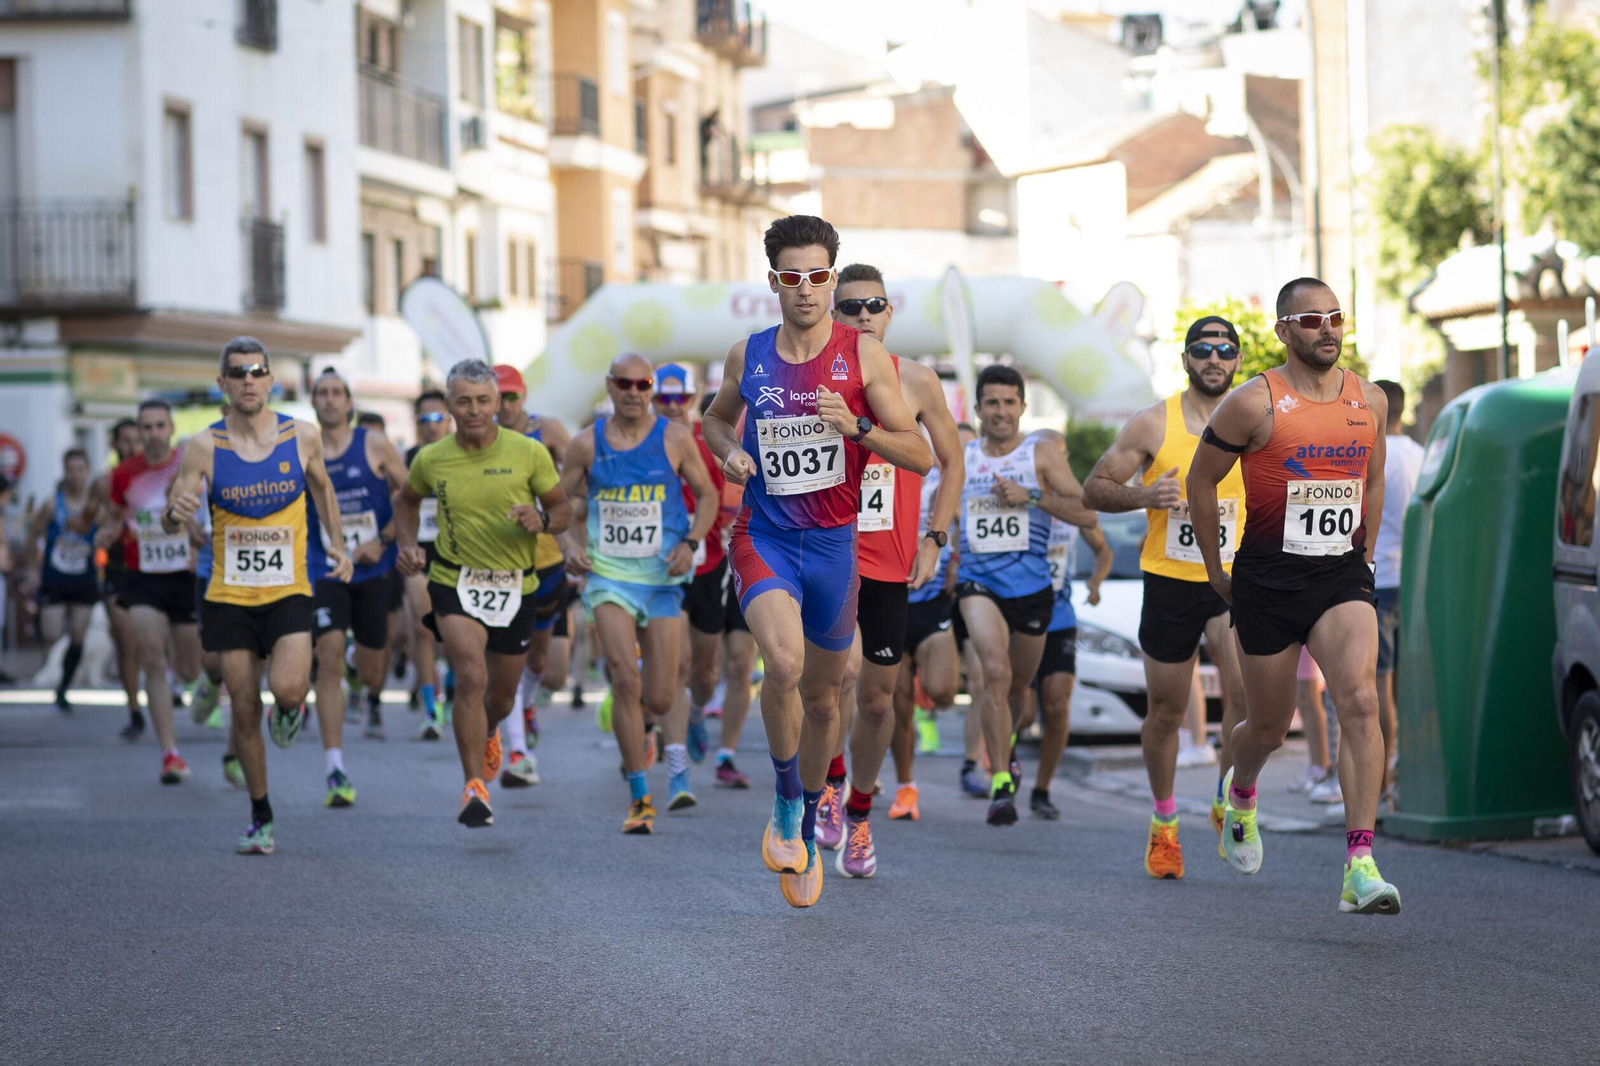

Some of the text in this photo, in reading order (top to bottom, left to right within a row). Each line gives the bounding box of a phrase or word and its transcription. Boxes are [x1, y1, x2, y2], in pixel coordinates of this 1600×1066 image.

[773, 423, 825, 438] FONDO
[1296, 439, 1367, 459] atracón
[765, 445, 839, 478] 3037
[1330, 459, 1365, 468] running
[221, 479, 296, 501] agustinos
[1306, 487, 1353, 499] FONDO
[611, 507, 649, 517] FONDO
[1300, 508, 1353, 536] 160
[239, 531, 280, 543] FONDO
[604, 524, 657, 545] 3047
[976, 516, 1020, 539] 546
[145, 543, 187, 562] 3104
[236, 549, 283, 572] 554
[467, 589, 512, 612] 327
